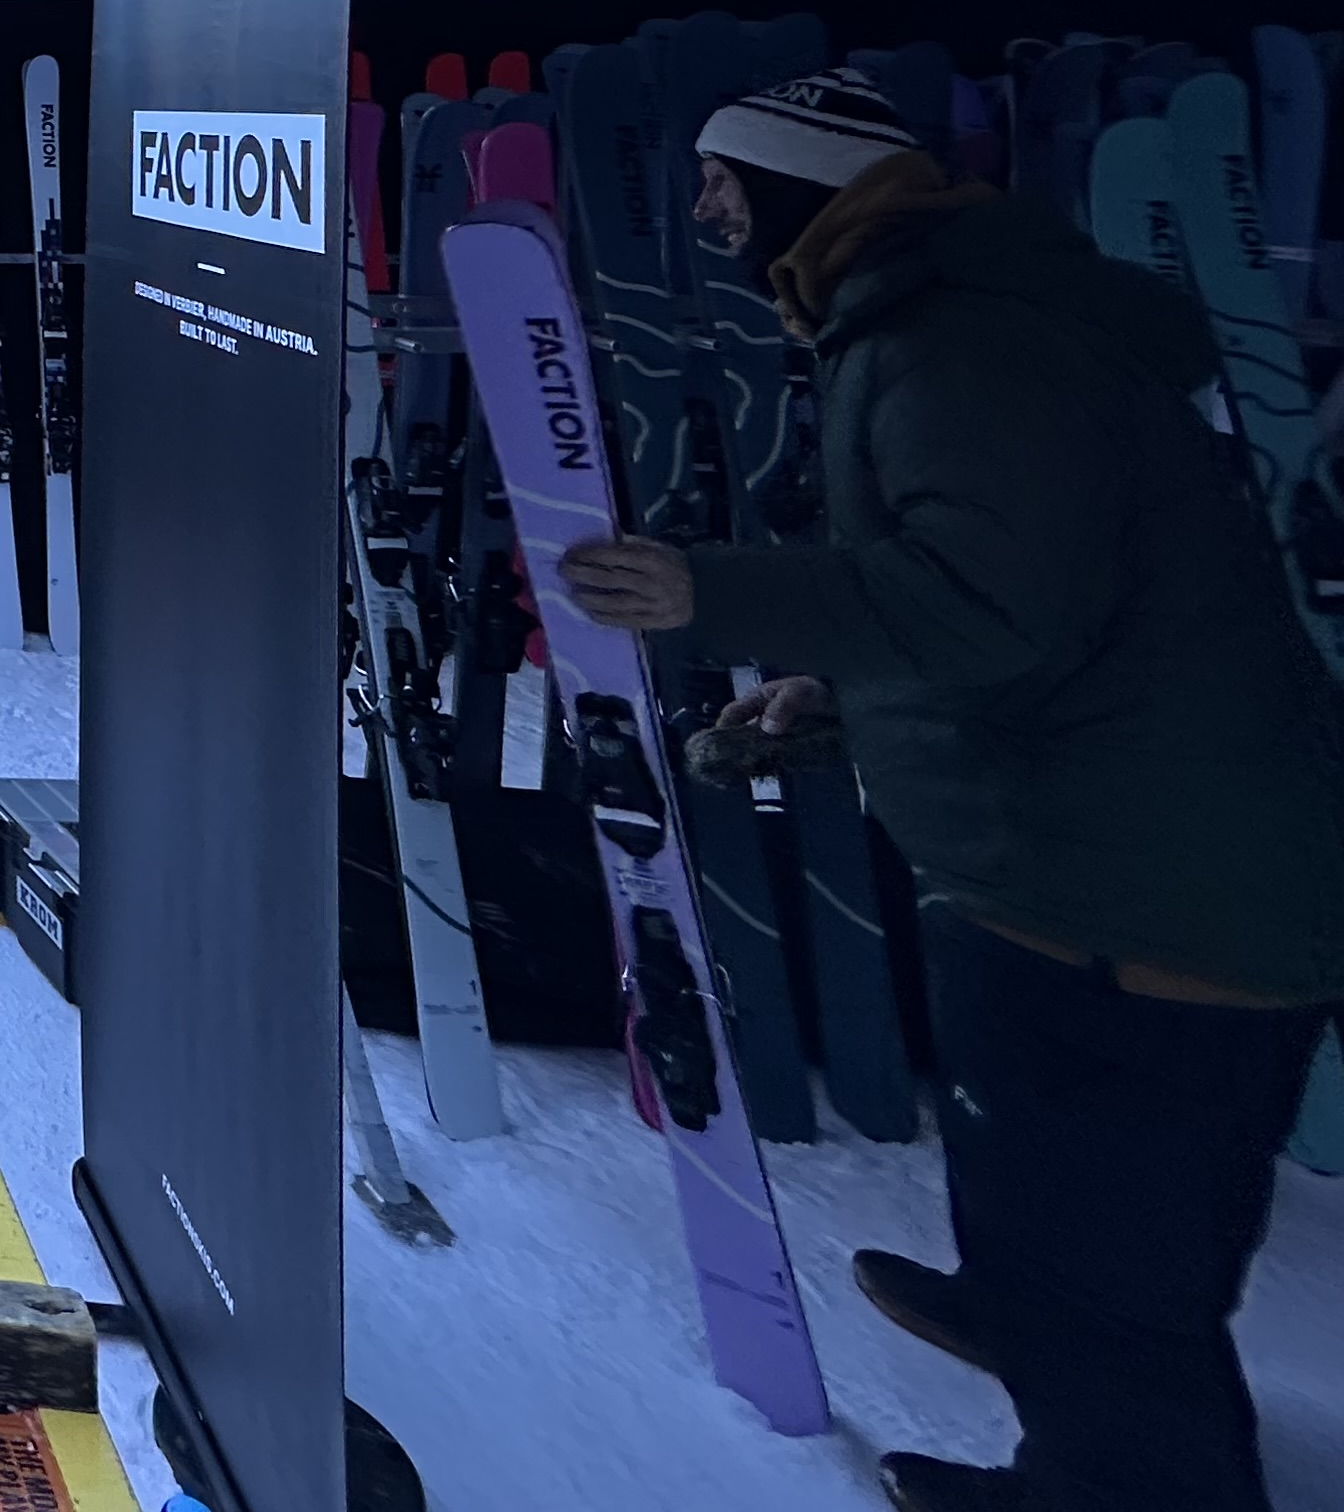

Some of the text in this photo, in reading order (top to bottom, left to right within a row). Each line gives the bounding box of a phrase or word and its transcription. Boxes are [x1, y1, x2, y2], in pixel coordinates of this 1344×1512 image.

[40, 103, 57, 169] FACTION
[139, 130, 312, 226] FACTION
[179, 319, 240, 356] BUILT TO LAST.
[253, 320, 264, 339] IN
[264, 324, 319, 357] AUSTRIA.
[525, 316, 592, 471] FACTION
[160, 1173, 235, 1316] FACTIONSKIS.COM
[12, 1437, 49, 1477] THE
